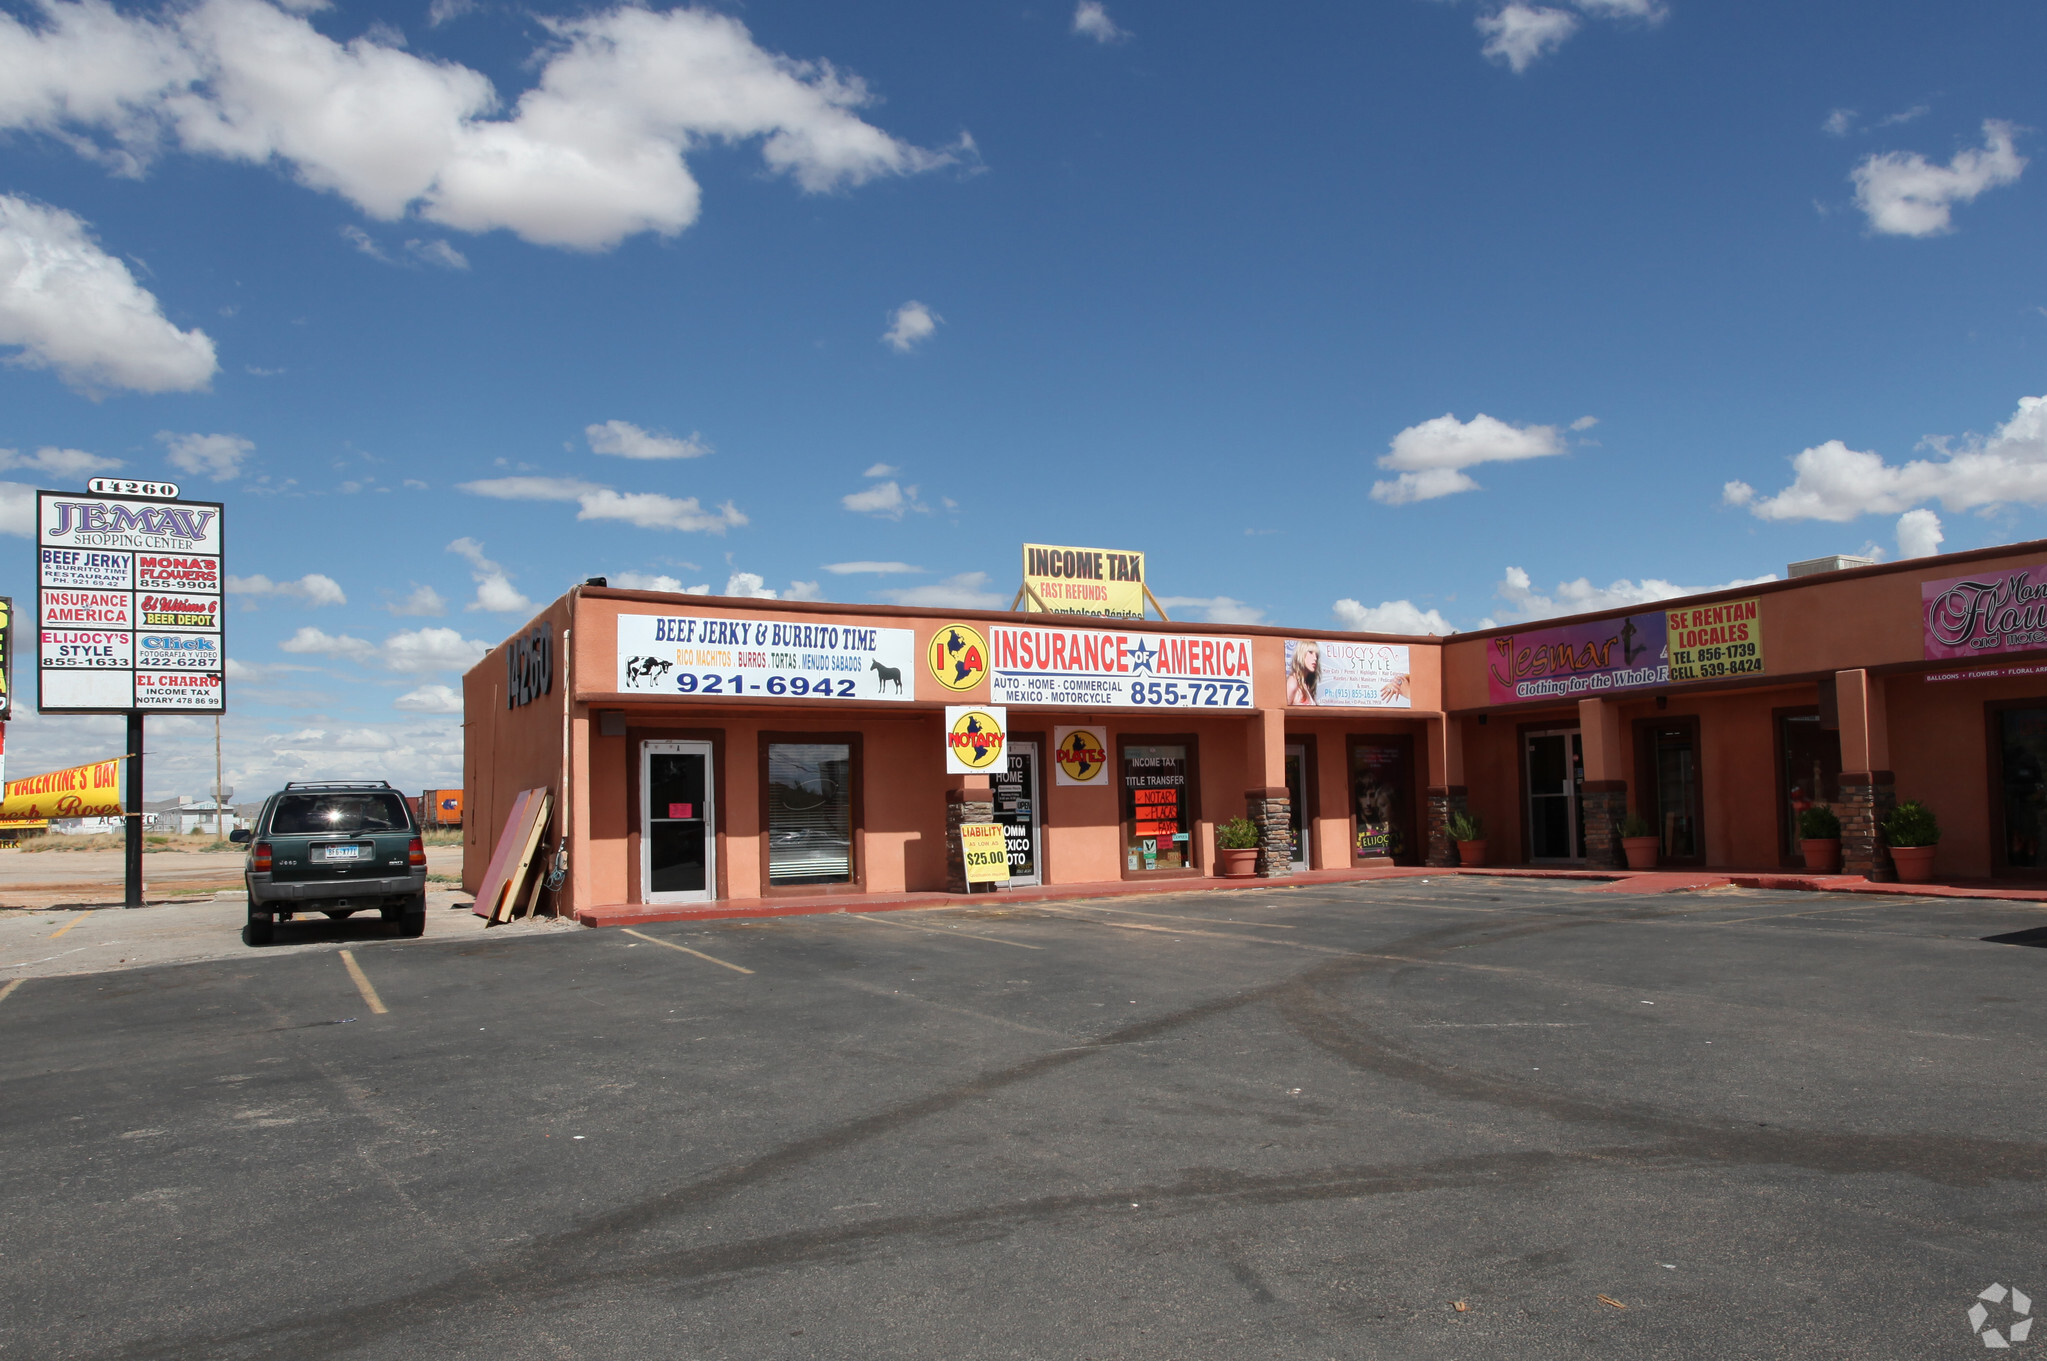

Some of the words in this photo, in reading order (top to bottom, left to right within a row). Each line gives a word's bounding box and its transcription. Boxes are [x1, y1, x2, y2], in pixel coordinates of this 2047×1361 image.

[95, 480, 174, 496] 14260
[49, 502, 216, 541] JEMAV
[74, 533, 143, 547] SHOPPING
[145, 536, 193, 550] CENTER
[42, 549, 80, 565] BEEF
[84, 553, 131, 569] JERKY
[1028, 547, 1103, 580] INCOME
[1106, 553, 1142, 582] TAX
[55, 564, 101, 573] BURRITO
[140, 568, 218, 582] FLOWERS
[44, 570, 128, 582] RESTAURANT
[140, 579, 218, 589] 855-9904
[1040, 582, 1063, 599] FAST
[1065, 584, 1108, 601] REFUNDS
[45, 593, 128, 607] INSURANCE
[208, 600, 218, 614] 6
[46, 608, 127, 622] AMERICA
[147, 613, 175, 624] BEER
[177, 614, 212, 626] DEPOT
[1670, 612, 1689, 631] SE
[1691, 601, 1757, 627] RENTAN
[42, 632, 129, 645] ELIJOCY'S
[655, 618, 697, 643] BEEF
[699, 620, 752, 646] JERKY
[755, 623, 767, 646] &
[771, 624, 839, 650] BURRITO
[842, 628, 877, 651] TIME
[1679, 623, 1749, 650] LOCALES
[1970, 632, 2000, 649] and
[141, 635, 216, 651] Click
[59, 645, 113, 657] STYLE
[994, 629, 1129, 673] INSURANCE
[1135, 651, 1150, 664] OF
[1156, 637, 1250, 677] AMERICA
[1326, 645, 1374, 659] ELIJOCY'S
[1674, 651, 1695, 665] TEL.
[1698, 643, 1756, 663] 856-1739
[42, 657, 130, 667] 855-1633
[140, 657, 217, 667] 422-6287
[506, 621, 553, 710] 14260
[676, 649, 694, 666] RICO
[696, 649, 732, 667] MACHITOS
[738, 651, 767, 668] BURROS
[771, 653, 797, 670] TORTAS
[802, 654, 830, 671] MENUDO
[831, 655, 862, 672] SABADOS
[1351, 657, 1391, 670] STYLE
[1491, 635, 1618, 687] Jesmar
[1670, 665, 1699, 681] CELL.
[1700, 658, 1762, 678] 539-8424
[1926, 673, 1959, 681] BALLOONS
[1968, 670, 1999, 678] FLOWERS
[2008, 667, 2034, 675] FLORAL
[137, 675, 155, 686] EL
[158, 676, 219, 687] CHARRO
[676, 672, 856, 697] 921-6942
[993, 678, 1019, 689] AUTO
[1028, 679, 1055, 690] HOME
[1063, 680, 1122, 692] COMMERCIAL
[1517, 680, 1566, 697] Clothing
[1570, 674, 1588, 693] for
[1590, 673, 1611, 688] the
[1612, 667, 1655, 685] Whole
[1006, 690, 1042, 702] MEXICO
[1051, 691, 1112, 704] MOTORCYCLE
[1130, 681, 1250, 706] 855-7272
[1335, 689, 1350, 699] (915)
[1352, 689, 1378, 699] 855-1633
[948, 732, 1005, 748] NOTARY
[1056, 748, 1106, 763] PLATES
[1132, 758, 1160, 767] INCOME
[1161, 757, 1176, 767] TAX
[14, 766, 88, 796] VALENTINE'S
[93, 762, 117, 788] DAY
[995, 770, 1023, 783] HOME
[1125, 776, 1145, 786] TITLE
[1146, 776, 1184, 786] TRANSFER
[1144, 791, 1176, 804] NOTARY
[56, 795, 121, 816] Roses
[1151, 806, 1177, 819] PLACAS
[962, 827, 1002, 837] LIABILITY
[1003, 825, 1026, 837] OMM
[967, 851, 1004, 866] $25.00
[1007, 853, 1026, 866] OTO
